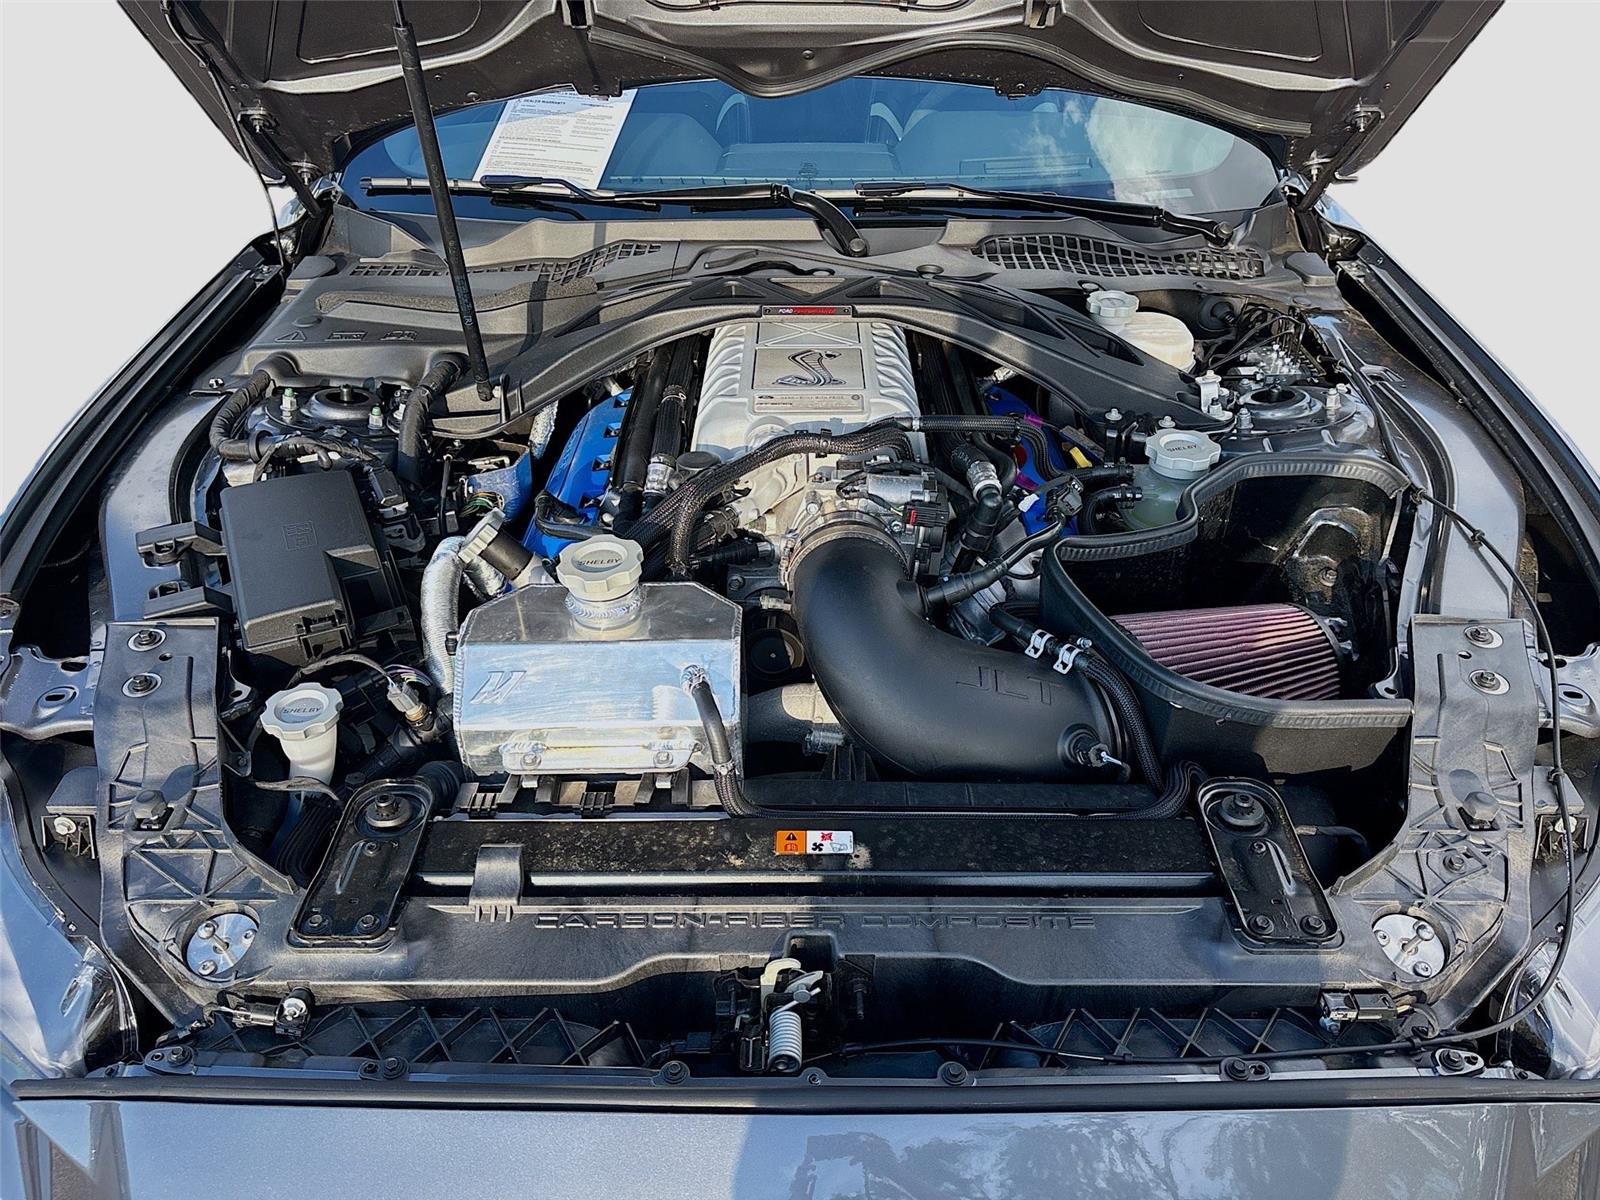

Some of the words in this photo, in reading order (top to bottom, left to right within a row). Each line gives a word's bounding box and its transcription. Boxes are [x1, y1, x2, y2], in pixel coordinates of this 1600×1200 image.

[1166, 444, 1197, 452] SHELBY
[576, 558, 620, 566] SHELBY
[956, 665, 1064, 706] JLT
[281, 706, 320, 714] SHELBY
[534, 912, 845, 929] CARBON-FIBER
[860, 914, 1097, 929] COMPOSITE
